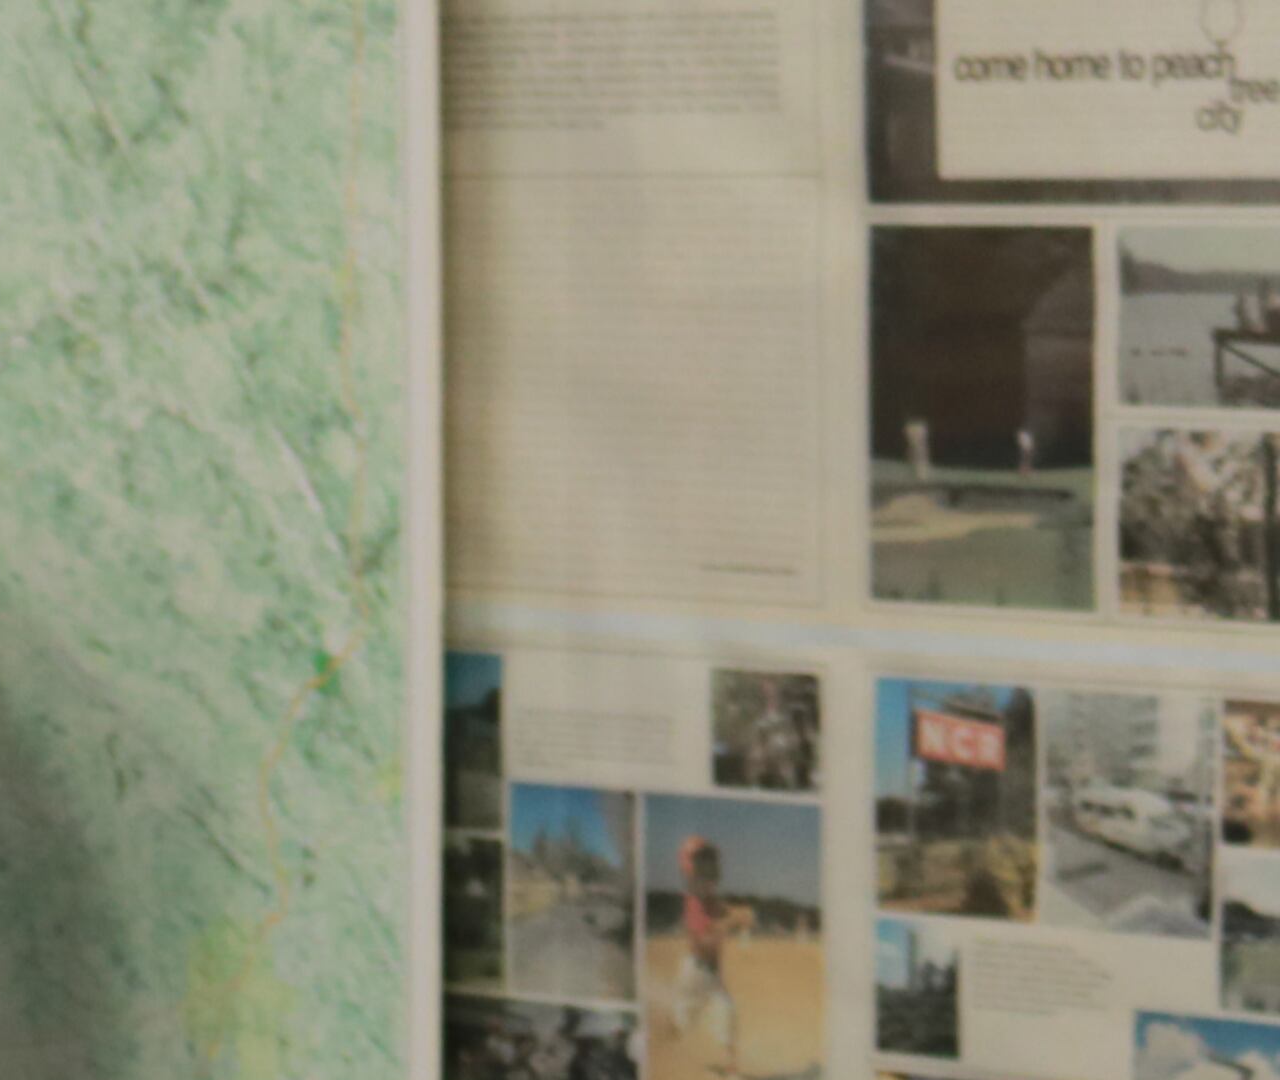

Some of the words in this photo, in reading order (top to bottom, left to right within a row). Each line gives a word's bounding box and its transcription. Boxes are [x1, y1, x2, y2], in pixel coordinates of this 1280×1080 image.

[953, 55, 1028, 82] come
[1034, 49, 1111, 82] home
[1118, 50, 1145, 82] to
